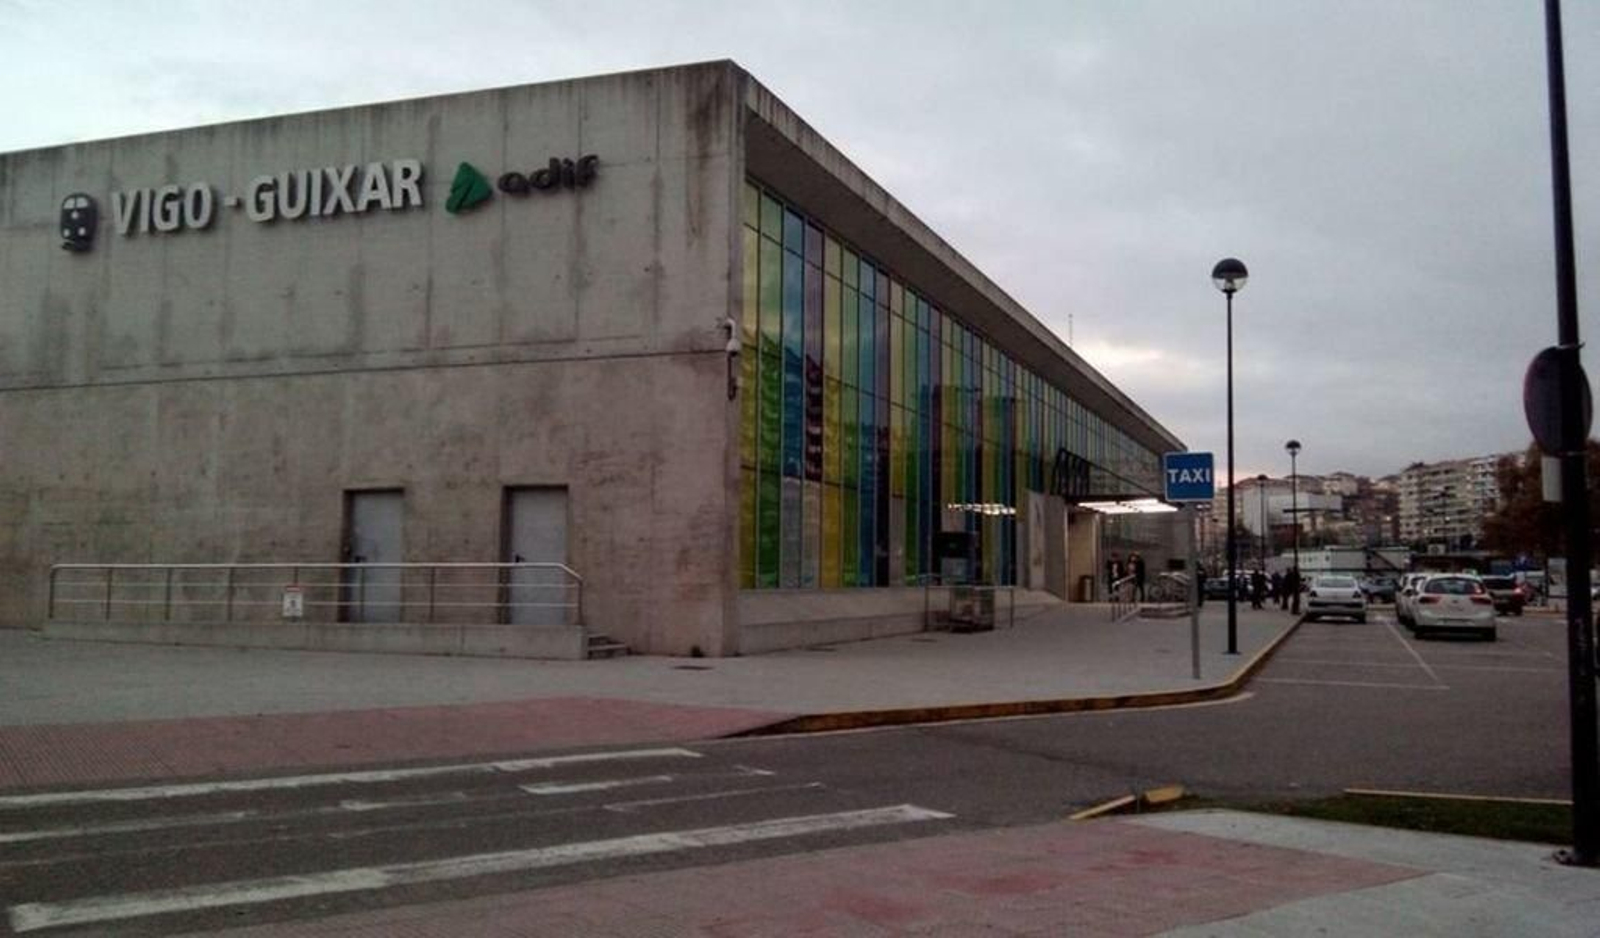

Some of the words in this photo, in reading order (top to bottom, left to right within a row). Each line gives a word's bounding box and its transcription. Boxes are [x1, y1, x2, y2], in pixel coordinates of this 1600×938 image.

[111, 181, 213, 235] VIGO
[246, 157, 423, 223] GUIXAR
[497, 154, 599, 196] adif
[1167, 468, 1211, 484] TAXI
